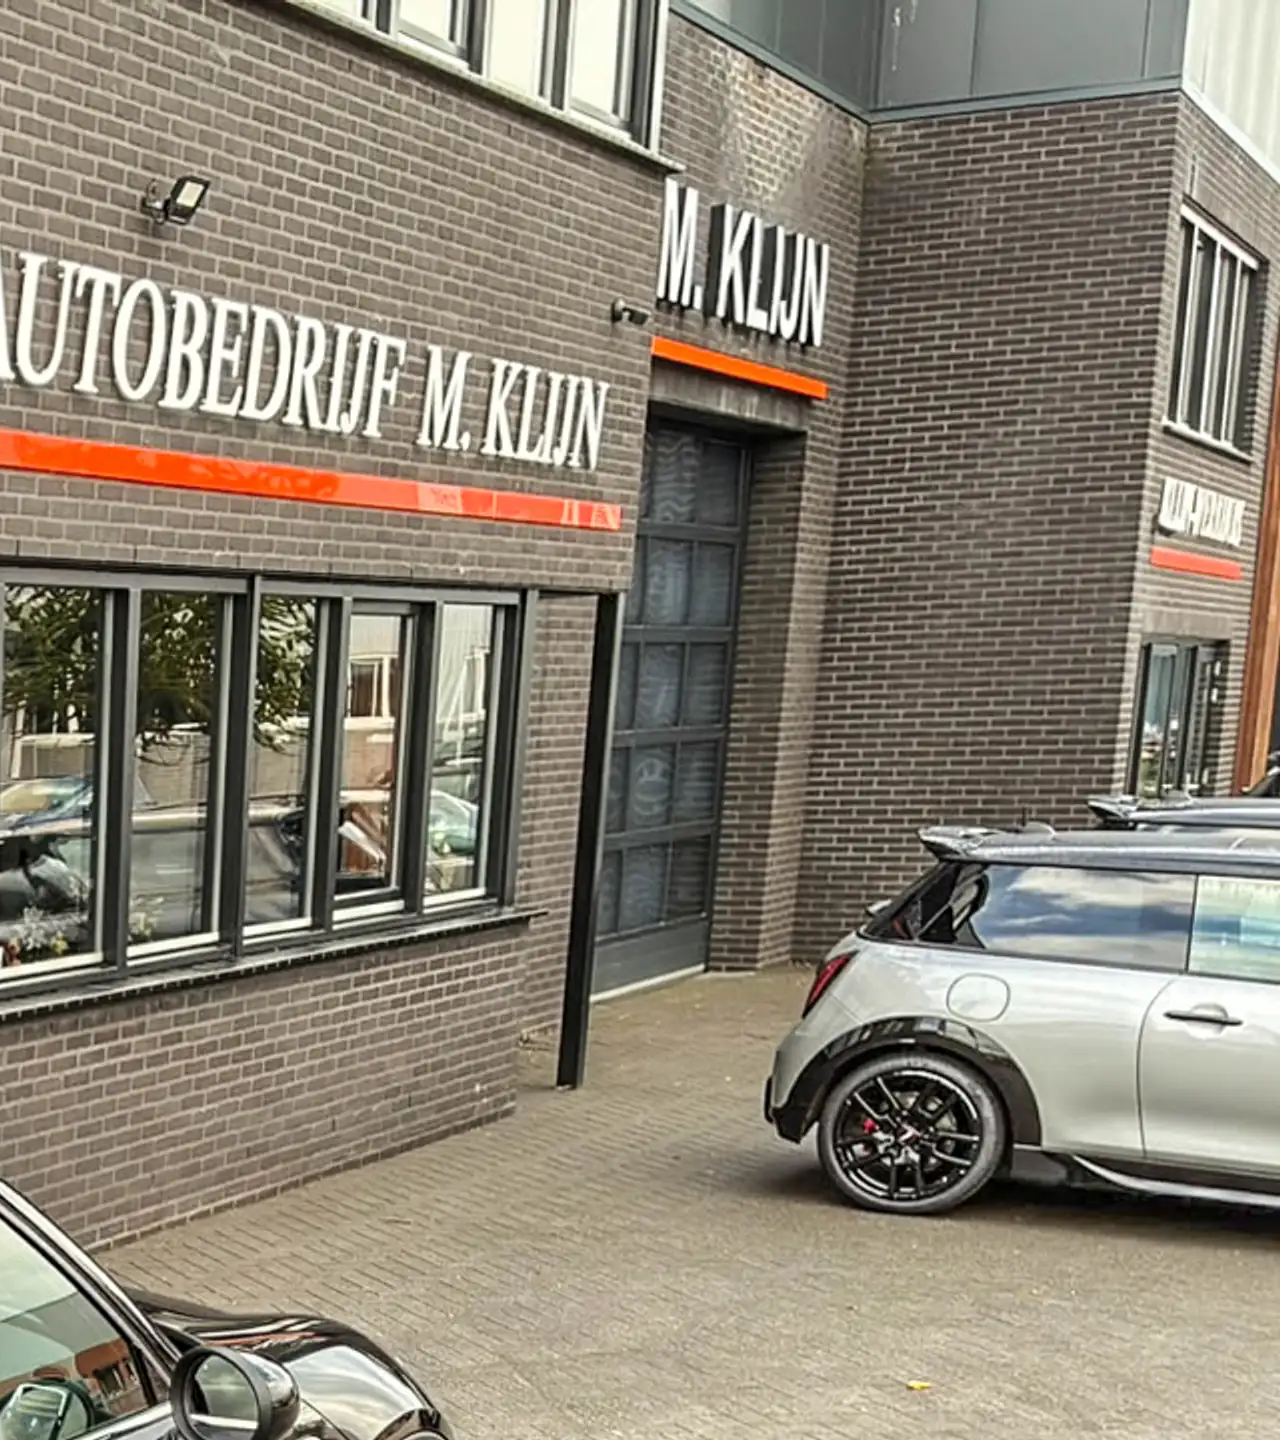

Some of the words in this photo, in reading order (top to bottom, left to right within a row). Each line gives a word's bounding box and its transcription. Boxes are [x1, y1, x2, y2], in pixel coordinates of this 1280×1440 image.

[656, 176, 703, 310] M.
[712, 203, 830, 348] KLIJN
[416, 344, 472, 451] M.
[480, 357, 610, 472] KLIJN
